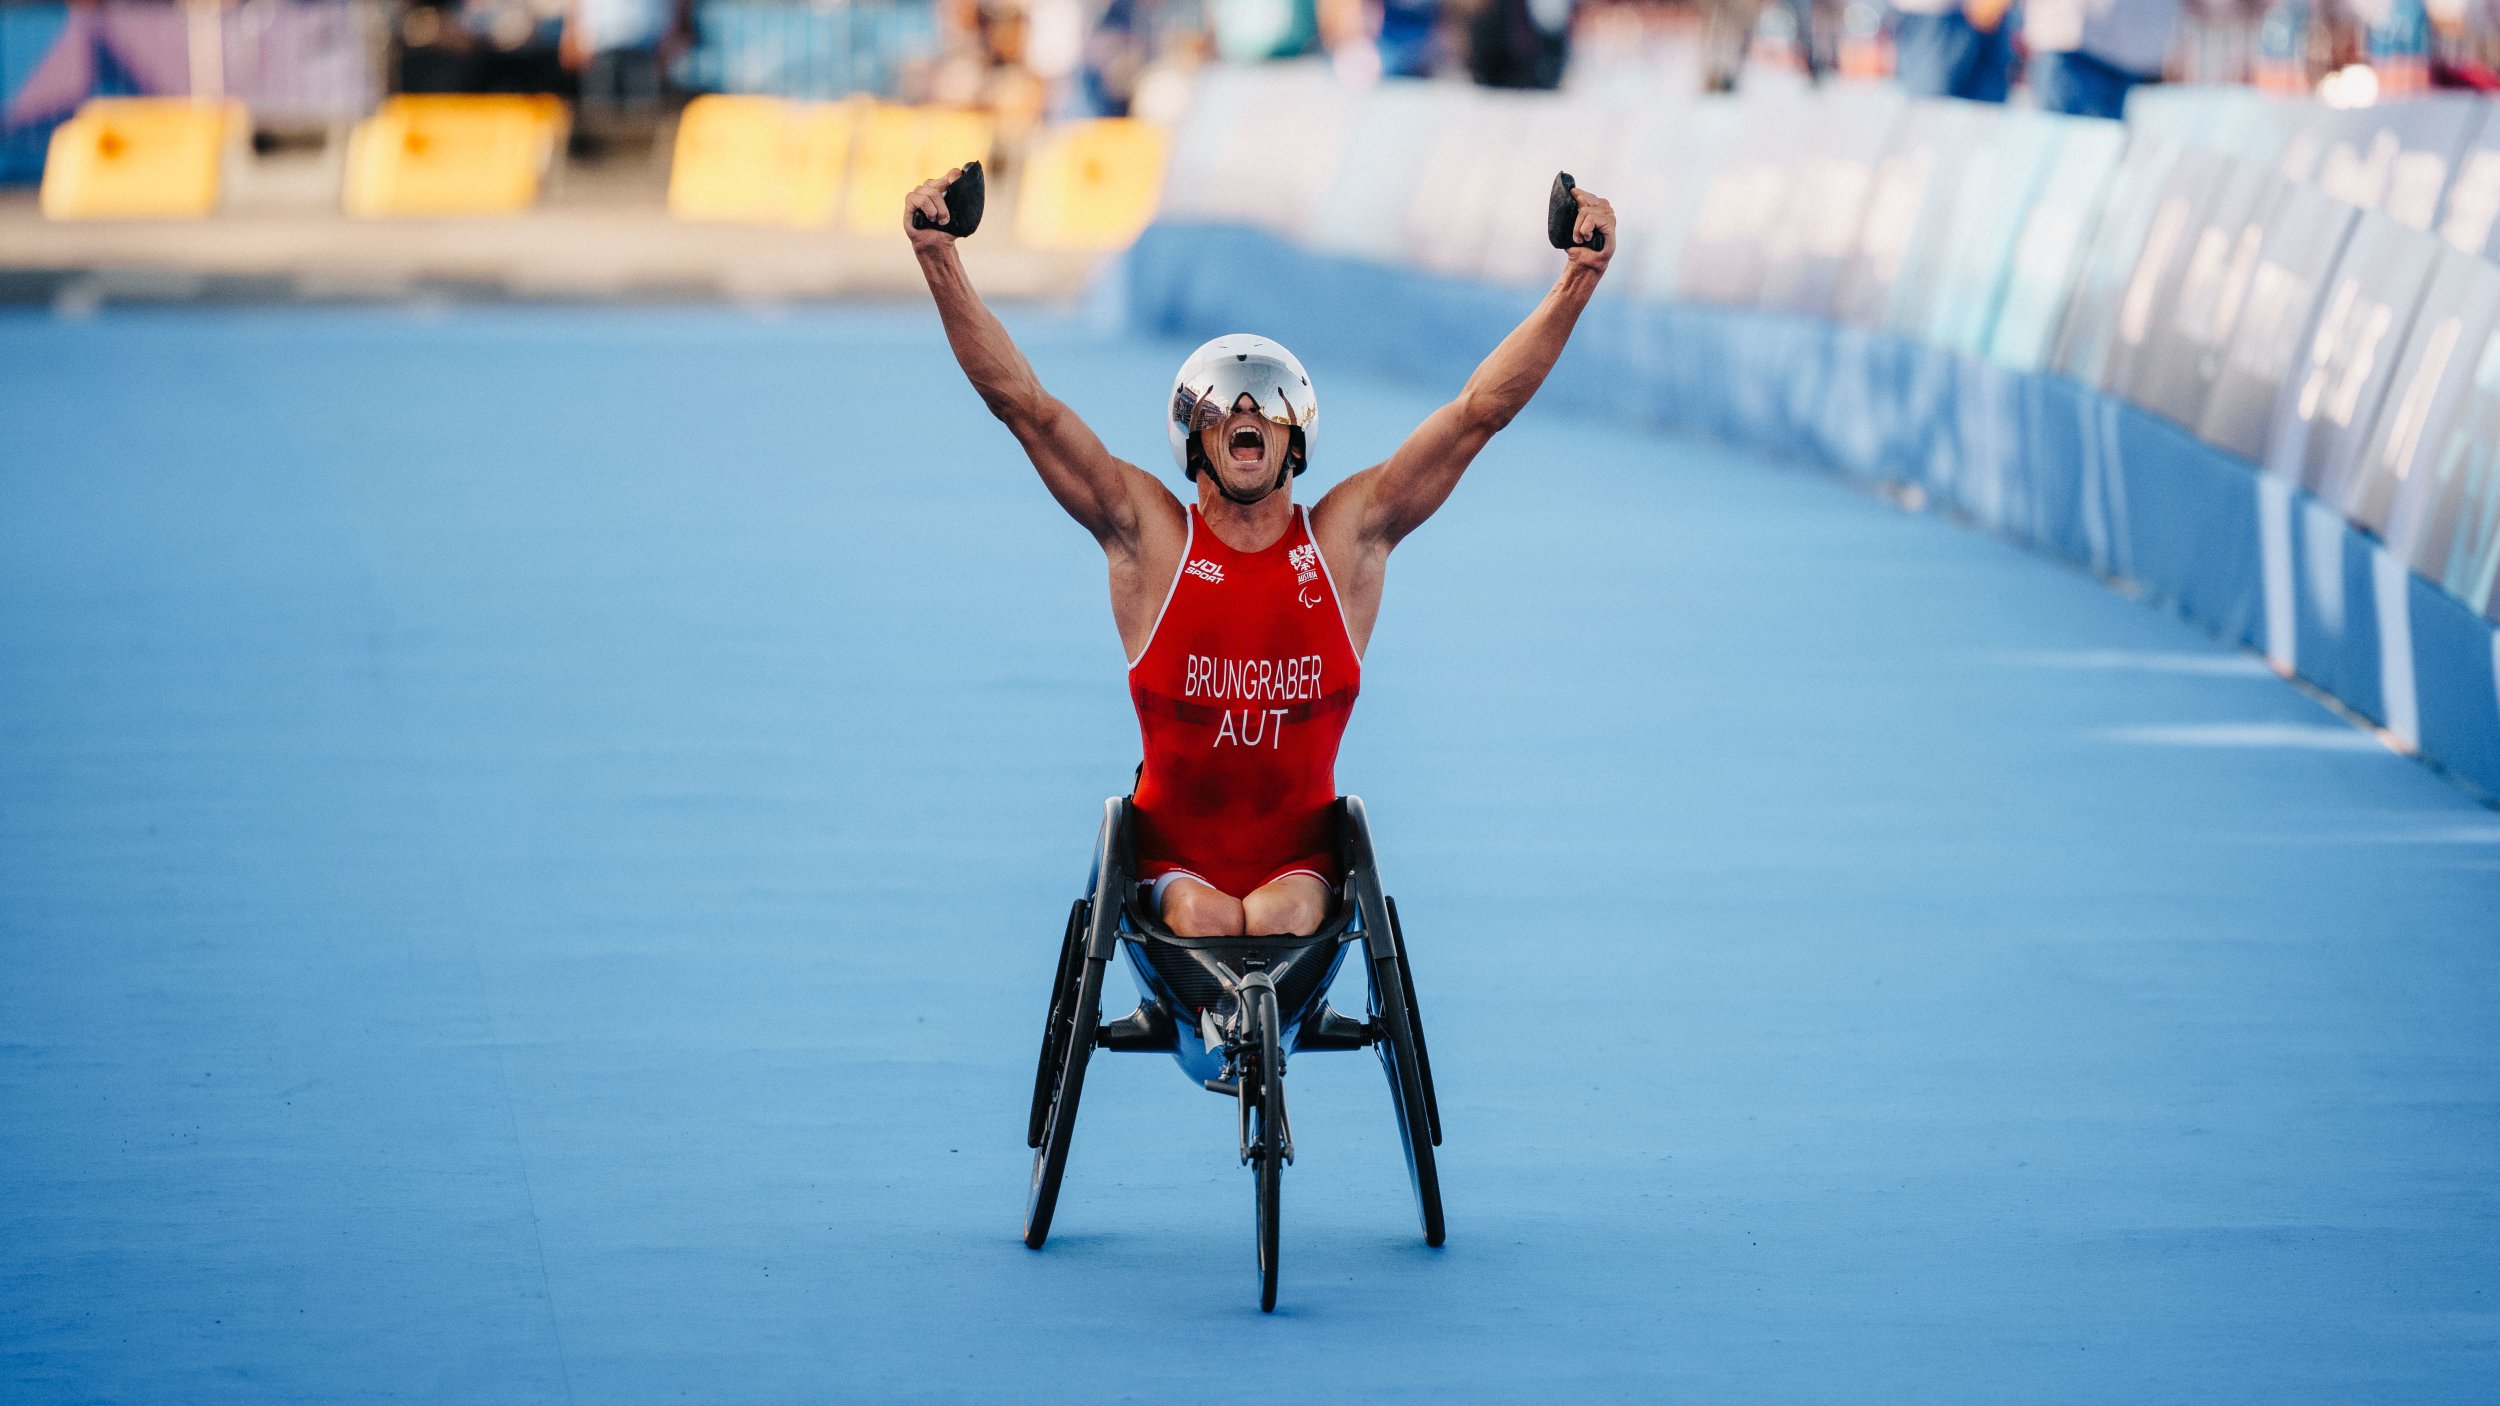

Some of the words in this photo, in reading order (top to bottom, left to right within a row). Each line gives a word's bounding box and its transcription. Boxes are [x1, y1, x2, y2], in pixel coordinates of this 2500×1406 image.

[1185, 566, 1224, 584] SPORT
[1189, 559, 1224, 577] JOL
[1297, 571, 1318, 584] AUSTRIA
[1185, 654, 1322, 700] BRUNGRABER
[1213, 708, 1289, 749] AUT
